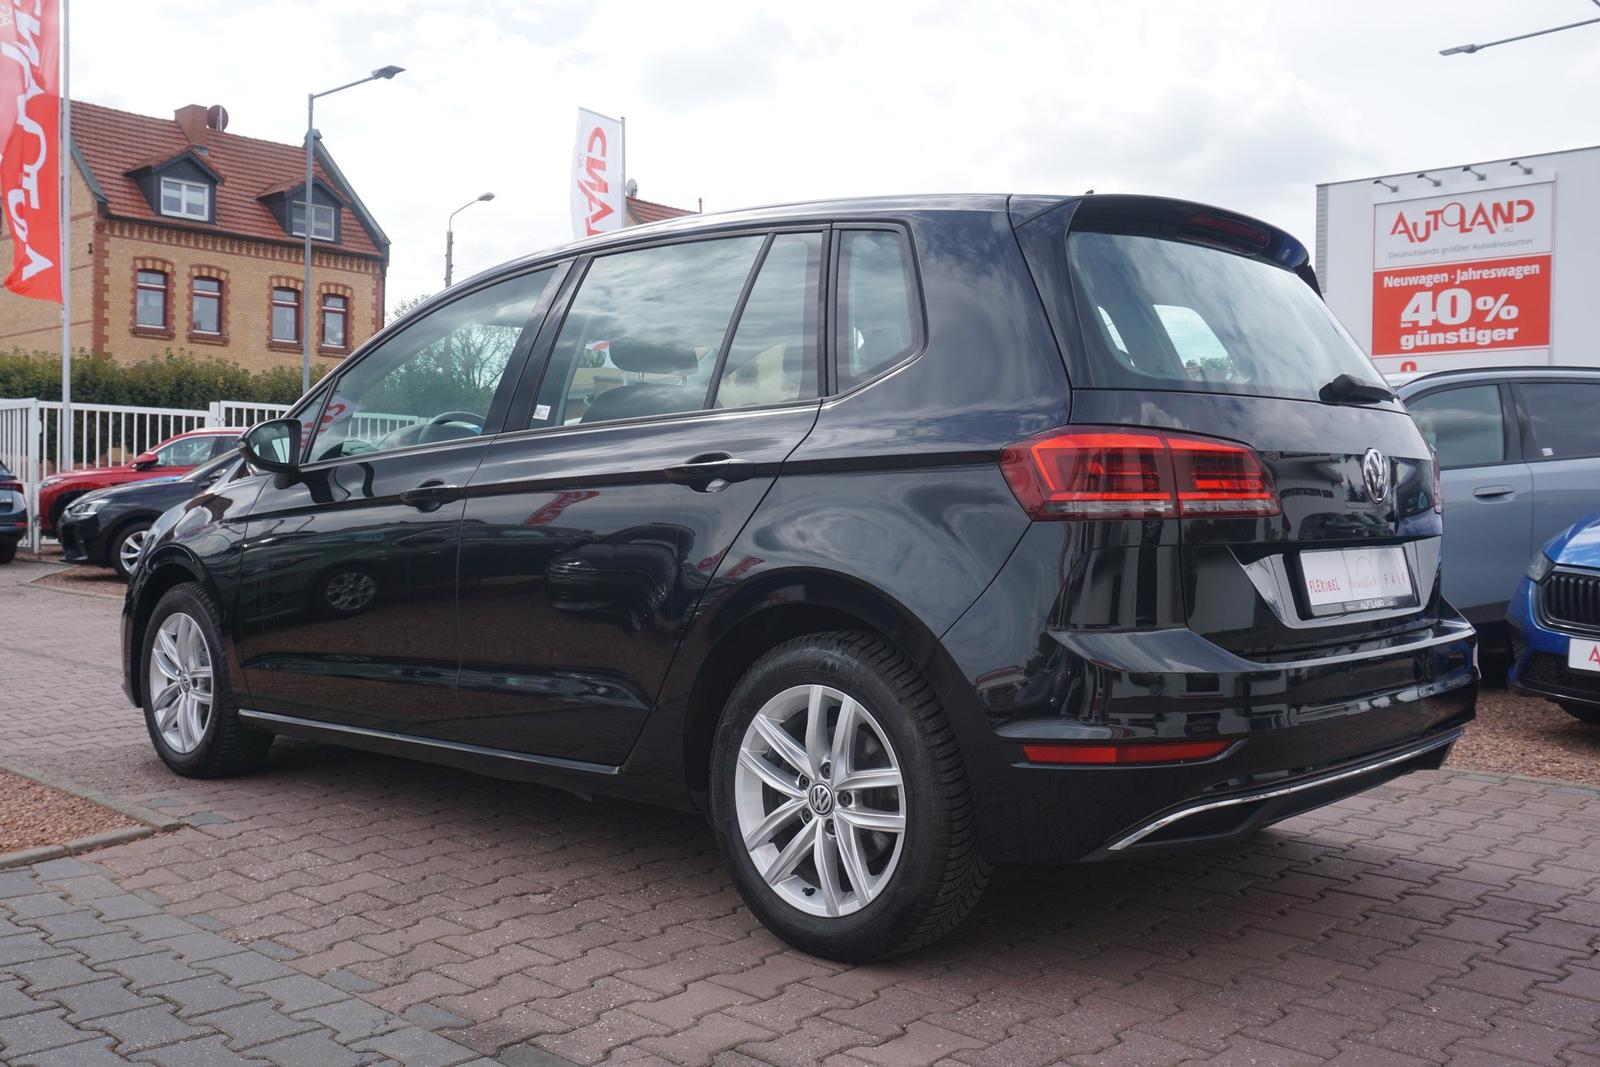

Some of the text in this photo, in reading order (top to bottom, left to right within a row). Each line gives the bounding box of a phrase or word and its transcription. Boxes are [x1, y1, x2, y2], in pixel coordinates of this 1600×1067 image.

[1391, 199, 1535, 243] AUTOLAND
[1389, 247, 1440, 259] Deutschlands
[1383, 272, 1448, 287] Neuwagen
[1455, 264, 1540, 284] Jahreswagen
[1400, 327, 1519, 350] günstiger
